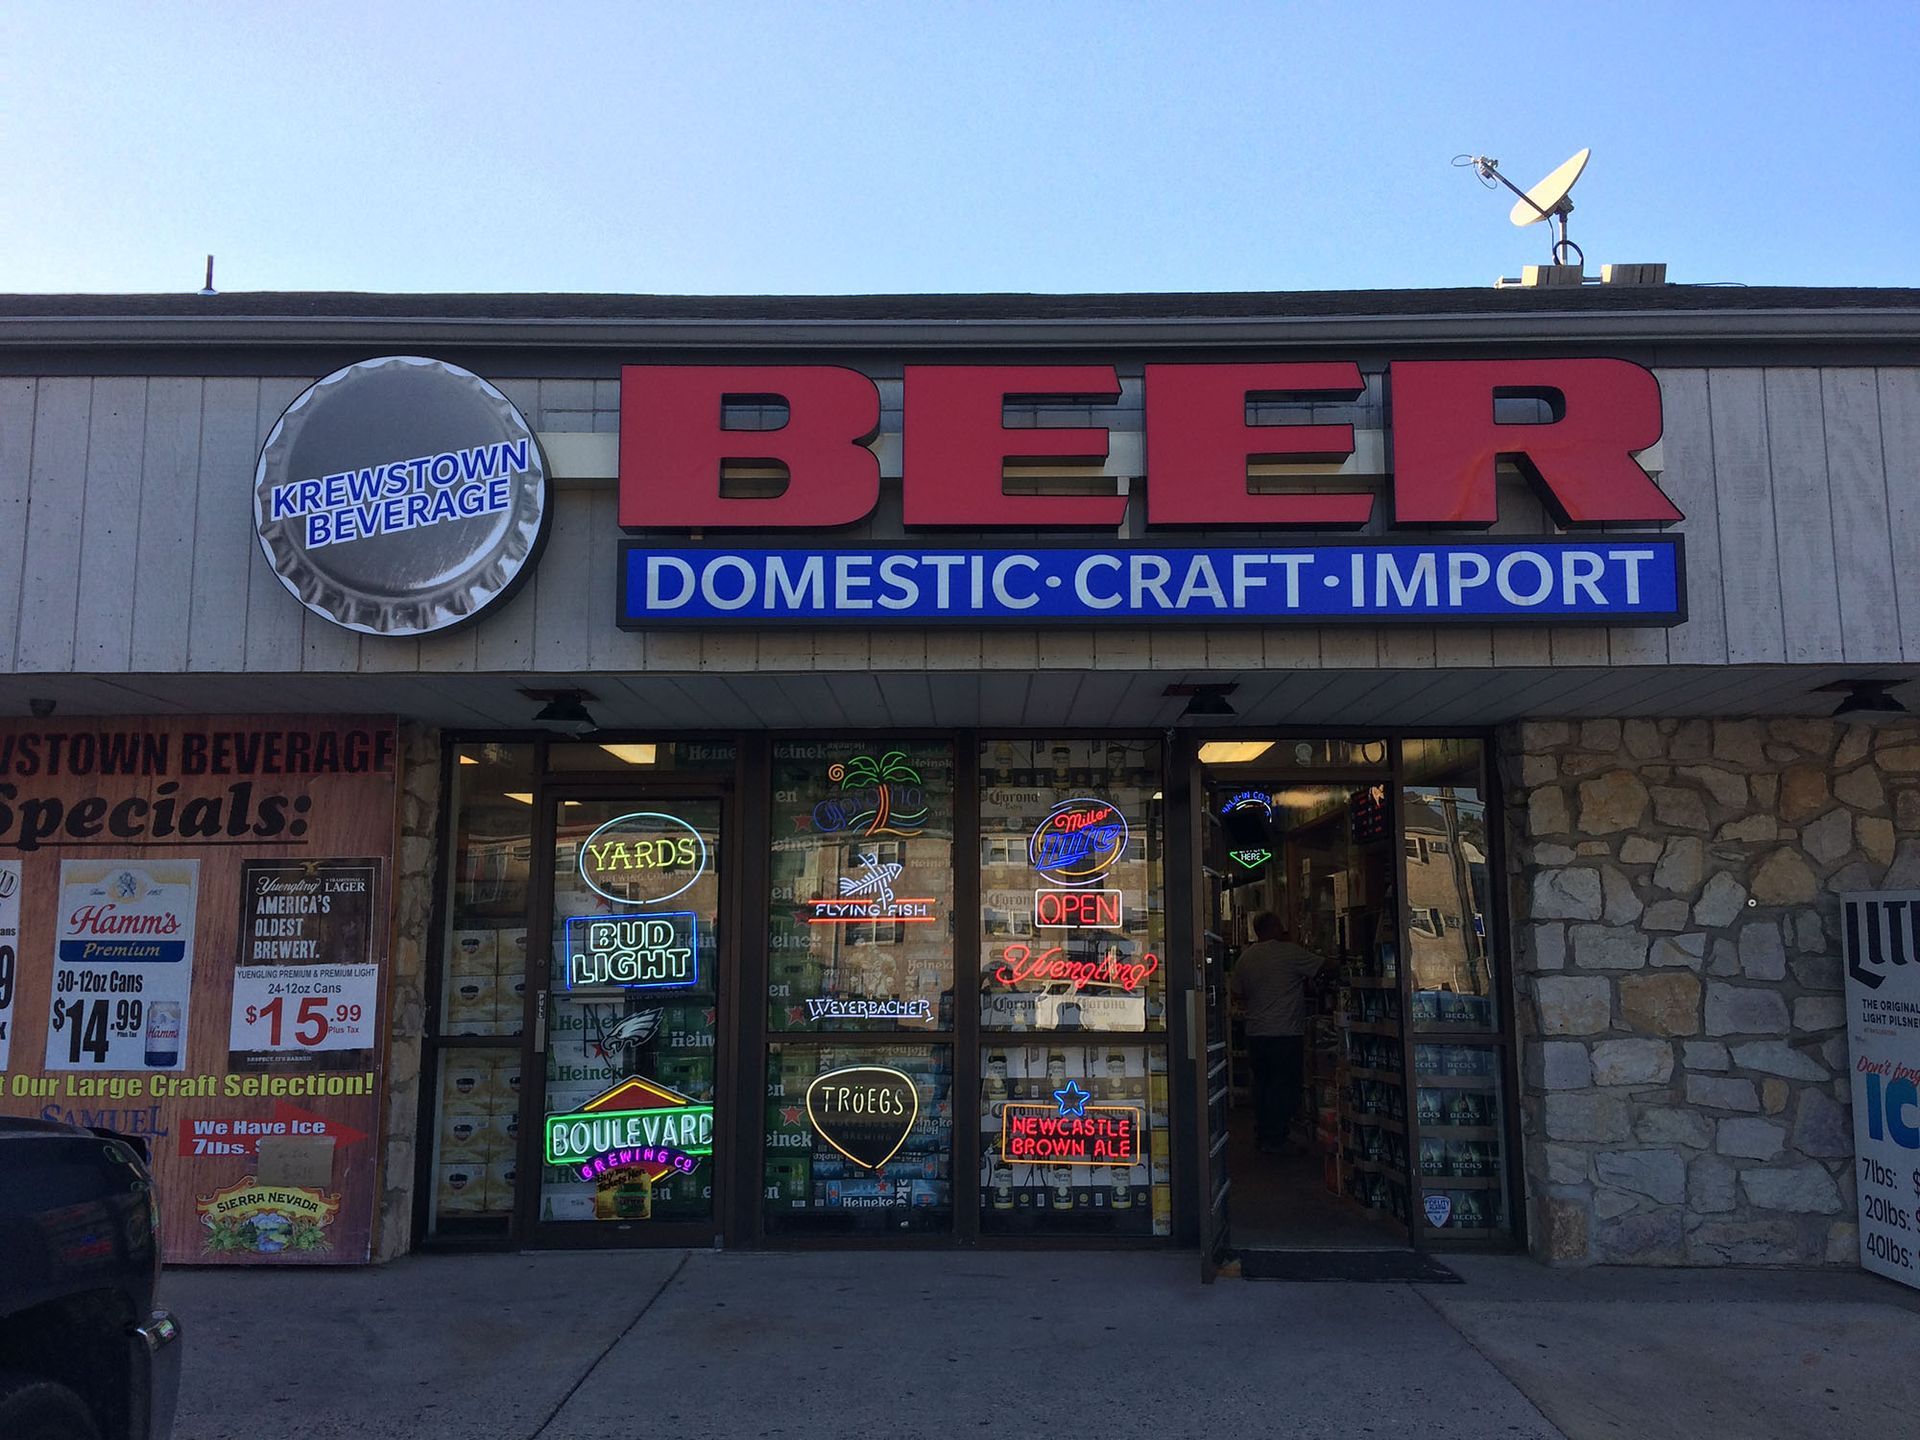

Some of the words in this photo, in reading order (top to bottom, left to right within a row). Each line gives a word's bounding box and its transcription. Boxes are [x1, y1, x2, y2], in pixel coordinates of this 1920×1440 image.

[619, 357, 1685, 530] BEER
[272, 439, 528, 519] KREWSTOWN
[306, 477, 510, 548] BEVERAGE
[0, 731, 167, 775] STOWN
[181, 730, 394, 775] BEVERAGE
[1054, 807, 1113, 833] Miller
[588, 838, 697, 871] YARDS
[1240, 853, 1261, 861] HERE
[255, 875, 322, 895] Yuengling
[324, 882, 366, 893] LAGER
[256, 895, 331, 915] AMERICA'S
[816, 904, 881, 917] FLYING
[888, 903, 927, 916] FISH
[1039, 894, 1118, 924] OPEN
[67, 904, 182, 935] Hamm's
[255, 918, 304, 937] OLDEST
[590, 920, 675, 952] BUD
[82, 942, 161, 959] Premium
[253, 940, 320, 960] BREWERY.
[237, 969, 278, 979] YUENGLING
[279, 968, 312, 978] PREMIUM
[313, 968, 318, 977] &
[320, 968, 353, 977] PREMIUM
[354, 967, 376, 977] LIGHT
[572, 948, 692, 984] LIGHT
[995, 944, 1159, 991] Yuengling
[57, 970, 107, 992] 30-12oz
[110, 969, 143, 992] Cans
[268, 983, 311, 994] 24-12oz
[313, 982, 342, 993] Cans
[806, 999, 935, 1023] WEYERBACHER
[1862, 999, 1878, 1010] THE
[1880, 1000, 1920, 1014] ORIGINAL
[347, 1025, 360, 1033] Tax
[1863, 1012, 1887, 1025] LIGHT
[1889, 1015, 1920, 1028] PILSNE
[1857, 1055, 1892, 1076] Don't
[12, 1073, 60, 1098] Our
[66, 1073, 142, 1099] Large
[149, 1073, 217, 1098] Craft
[223, 1072, 374, 1097] Selection!
[822, 1085, 905, 1116] TRÖEGS
[193, 1120, 228, 1135] We
[233, 1120, 286, 1135] Have
[291, 1119, 326, 1134] Ice
[553, 1113, 713, 1157] BOULEVARD
[1011, 1116, 1130, 1138] NEWCASTLE
[192, 1138, 250, 1155] 7lbs.
[1011, 1138, 1085, 1157] BROWN
[1094, 1139, 1130, 1158] ALE
[581, 1148, 669, 1179] BREWING
[1862, 1157, 1898, 1190] 7lbs:
[217, 1193, 265, 1214] SIERRA
[268, 1192, 319, 1213] NEVADA
[1865, 1194, 1911, 1231] 20lbs:
[1866, 1232, 1914, 1270] 40lbs:
